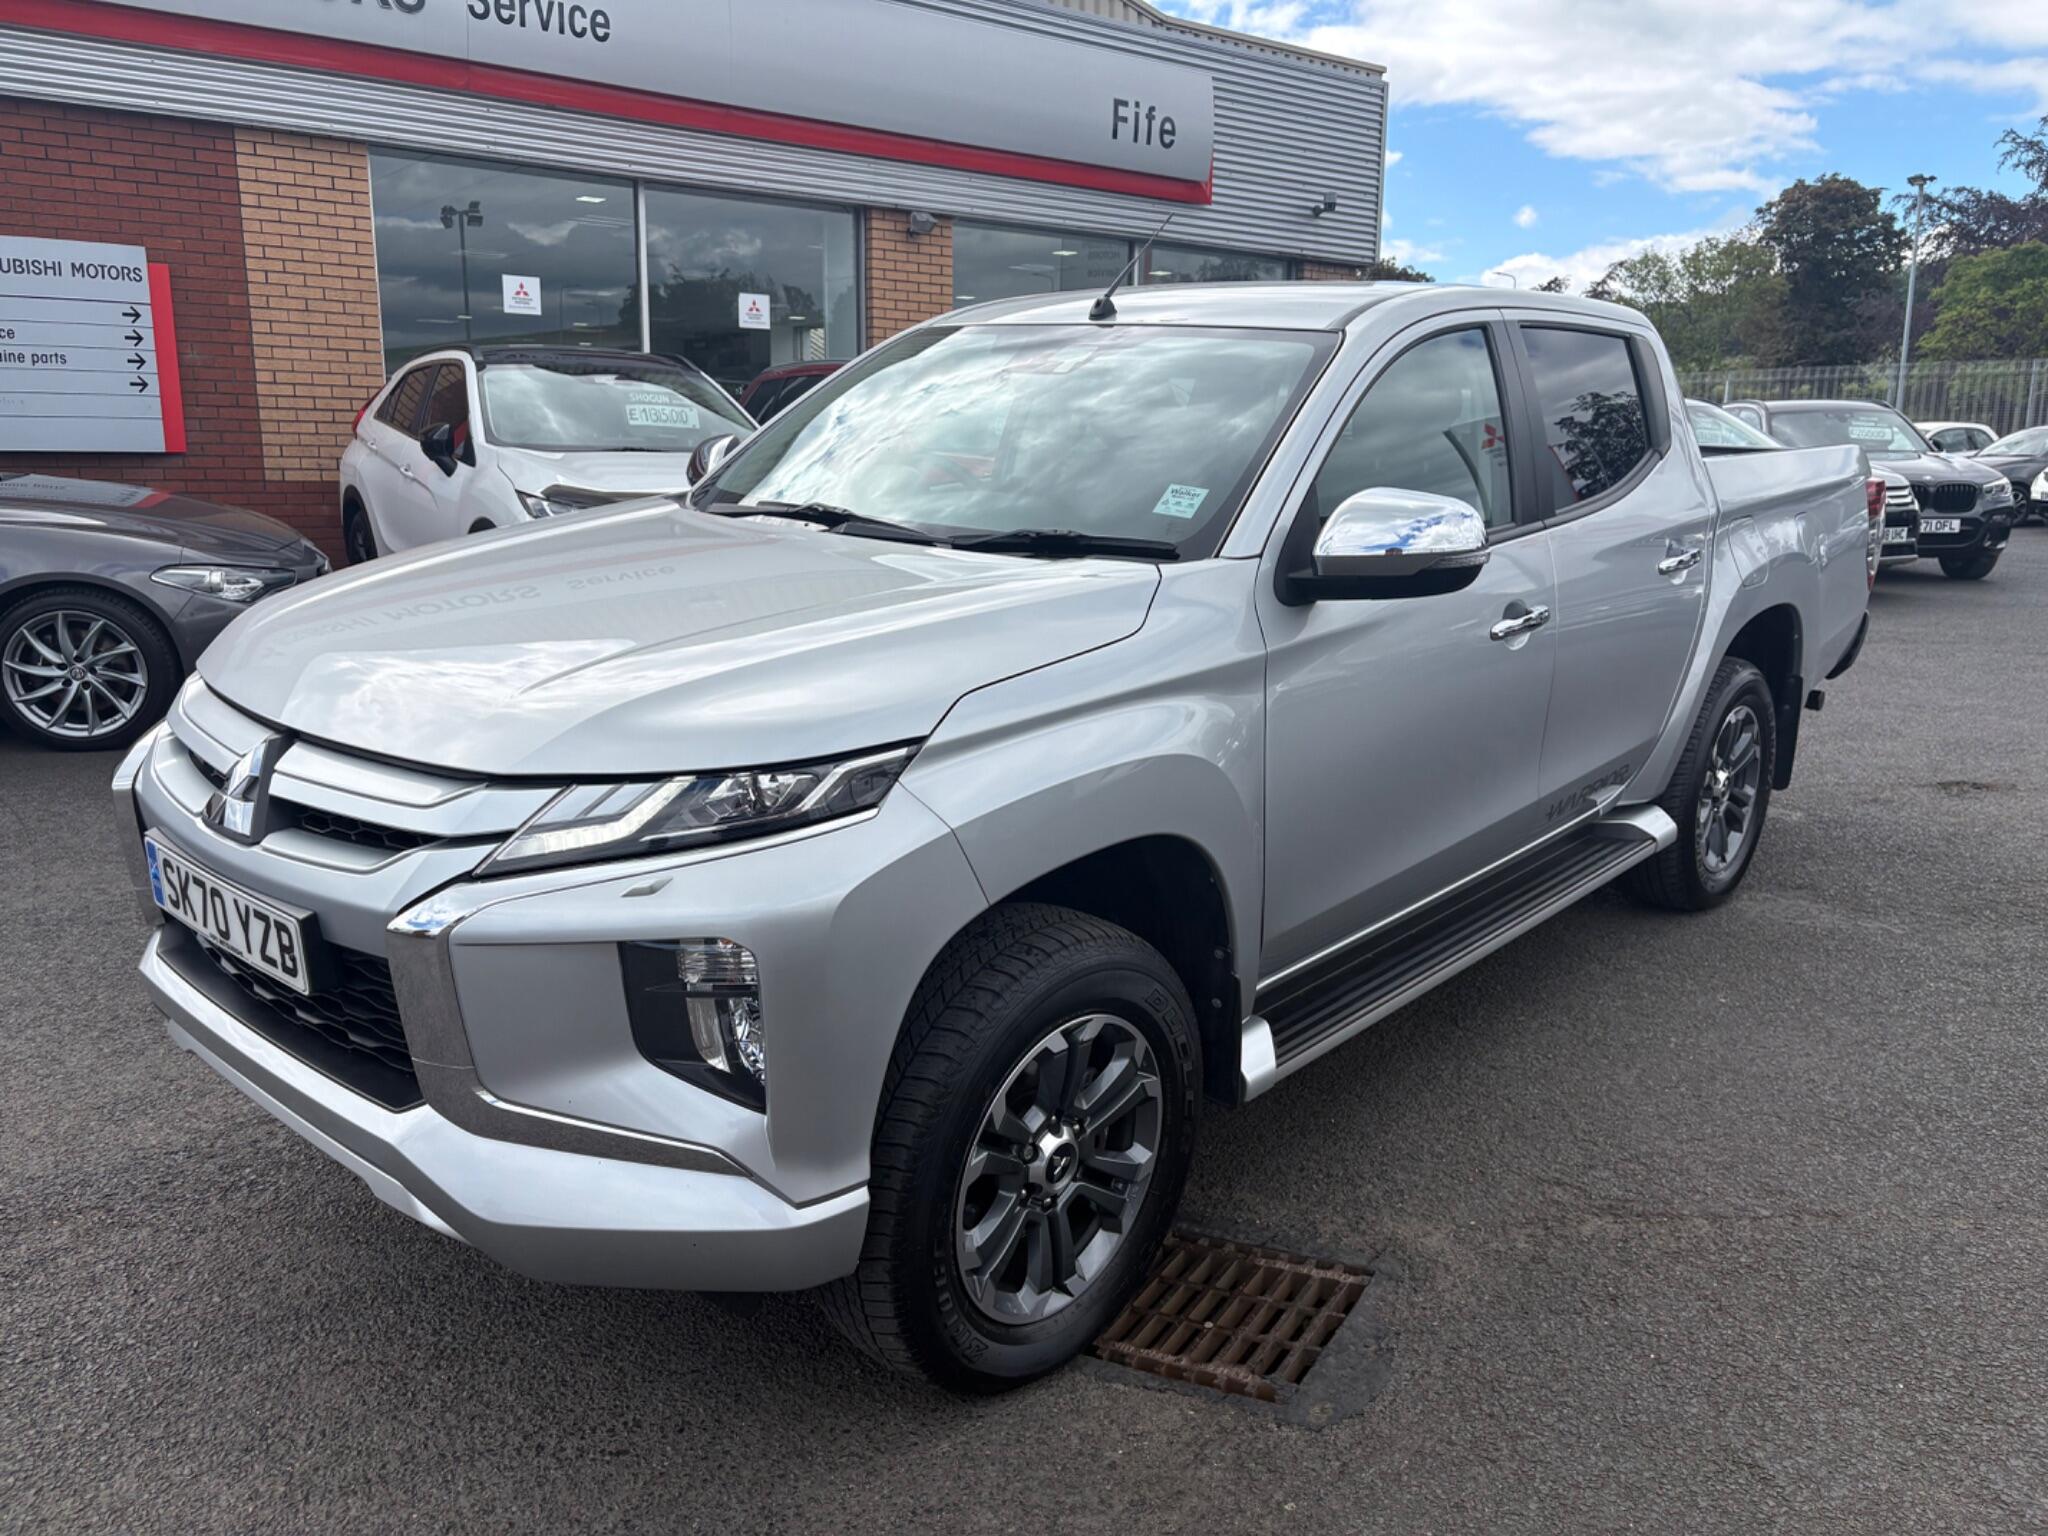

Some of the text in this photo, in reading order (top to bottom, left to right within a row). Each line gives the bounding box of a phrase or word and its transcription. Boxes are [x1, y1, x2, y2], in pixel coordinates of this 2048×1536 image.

[1111, 97, 1177, 150] Fife
[71, 261, 143, 283] MOTORS
[31, 352, 67, 367] parts
[162, 857, 299, 979] SK70 YZB
